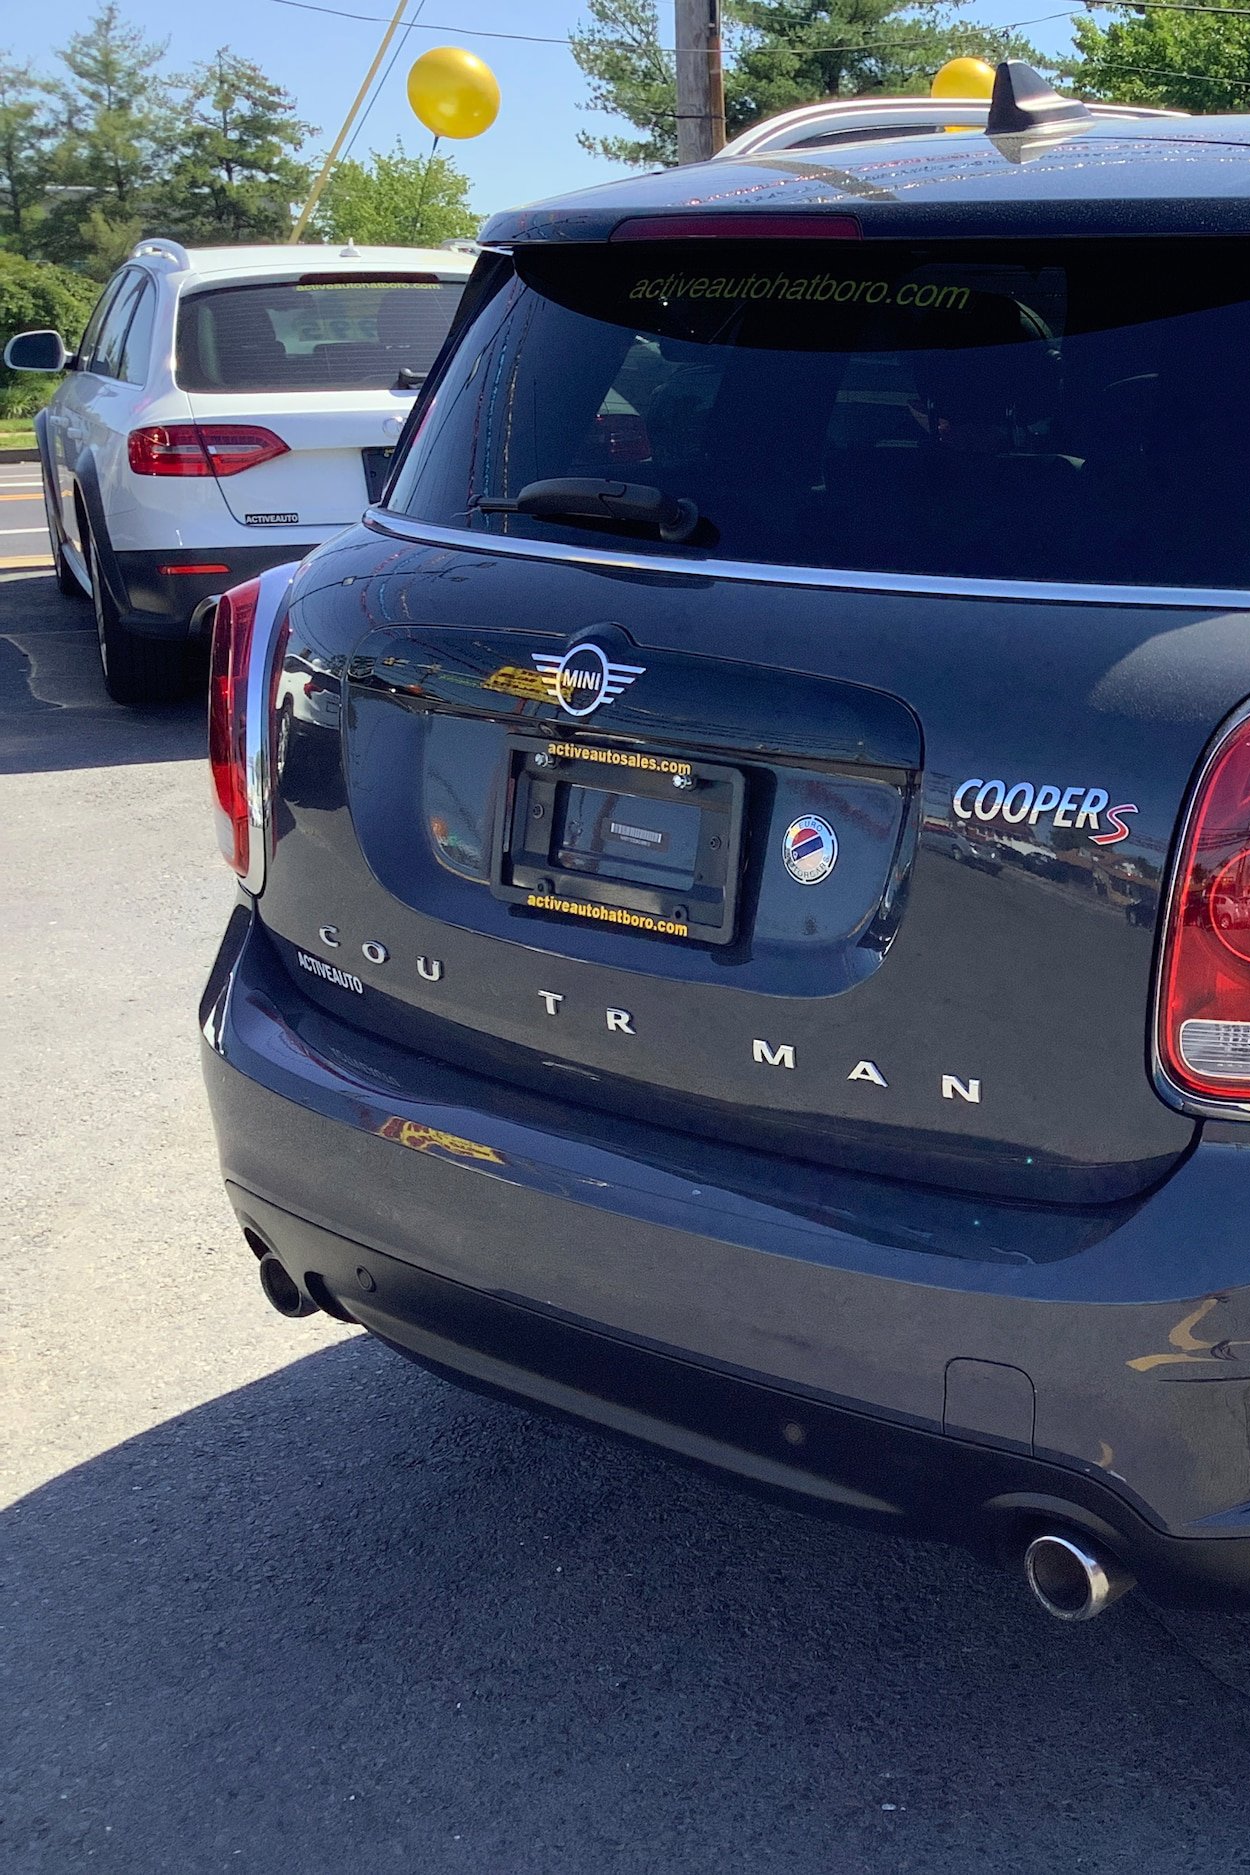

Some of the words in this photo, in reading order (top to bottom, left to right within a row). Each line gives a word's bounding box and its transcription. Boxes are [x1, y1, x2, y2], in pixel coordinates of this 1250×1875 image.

[629, 272, 971, 309] activeautohatboro.com
[246, 515, 298, 523] ACTIVEAUTO
[562, 668, 601, 691] MINI
[547, 742, 692, 775] activeautosales.com
[798, 821, 823, 832] EURO
[527, 893, 688, 937] activeautohatboro.com
[297, 951, 364, 995] ACTIVEAUTO
